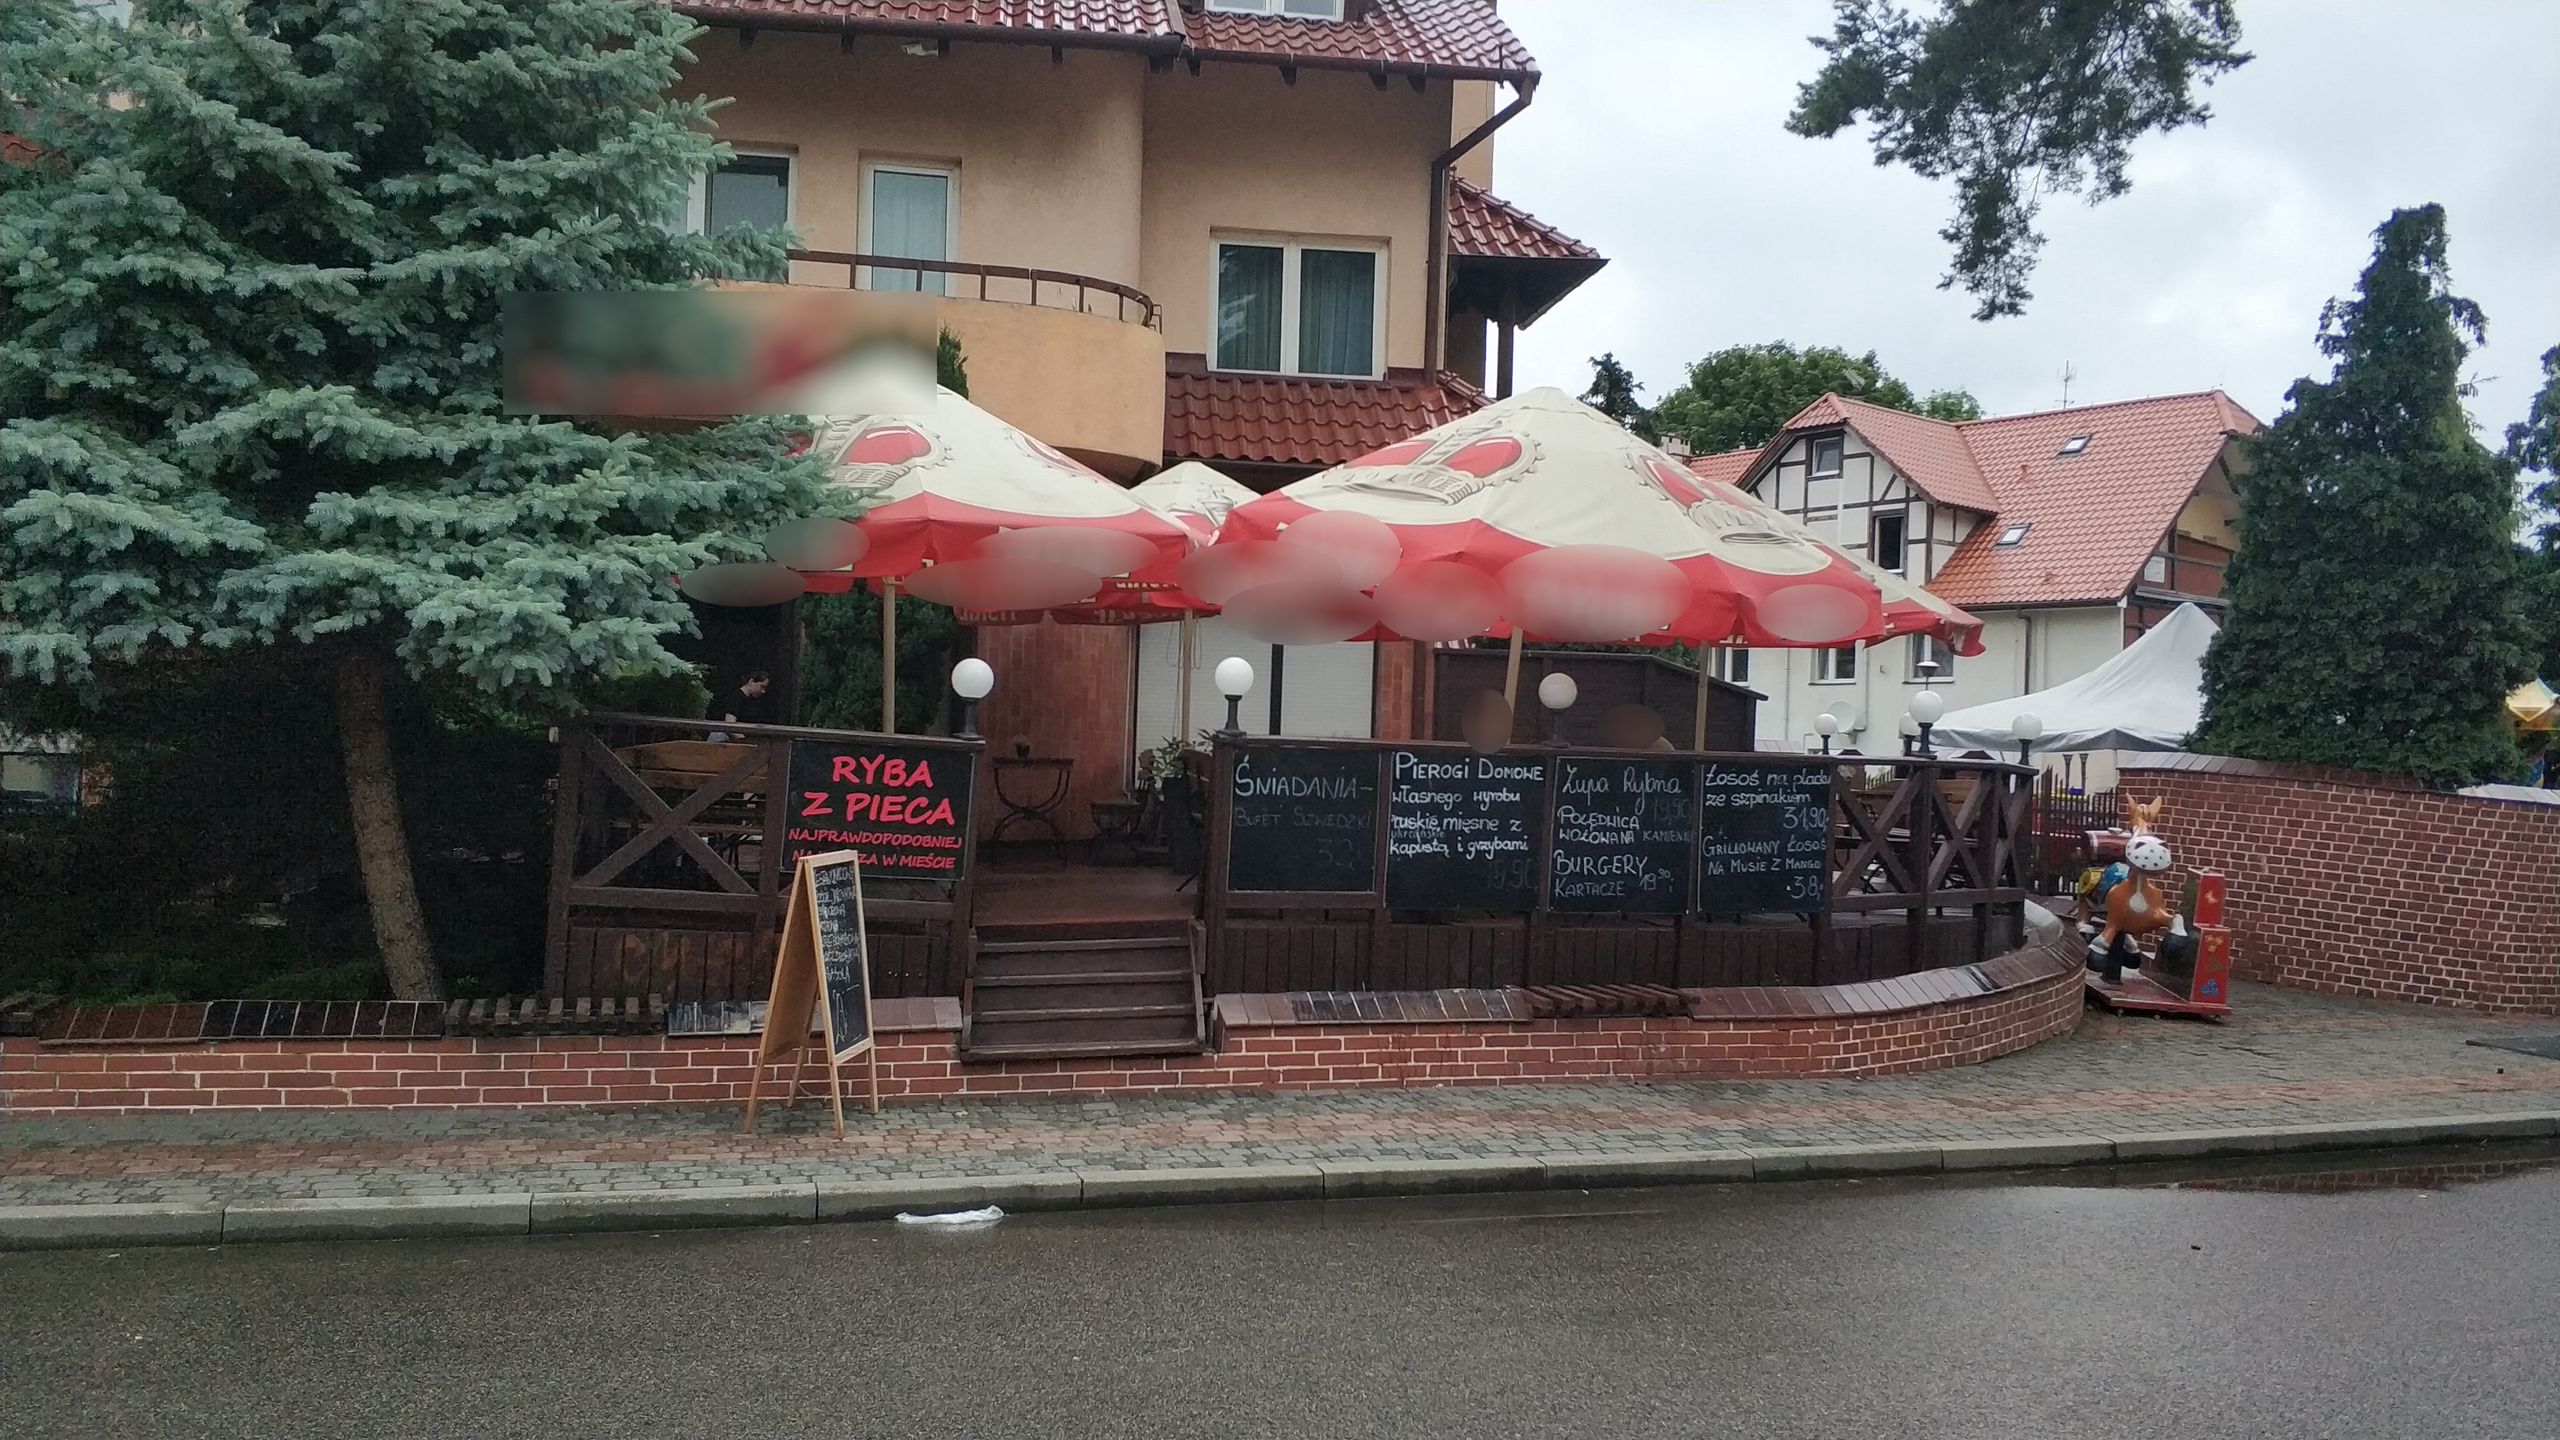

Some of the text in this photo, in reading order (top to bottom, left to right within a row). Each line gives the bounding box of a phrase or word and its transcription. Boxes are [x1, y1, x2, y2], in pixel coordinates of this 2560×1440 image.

[832, 754, 934, 789] RYBA
[1395, 751, 1544, 782] PIEROGI DOMOWE
[1705, 763, 1760, 786] Łosoś
[1766, 773, 1788, 786] na
[1392, 785, 1521, 811] własnego wyrobu
[1623, 766, 1682, 816] Rybna
[1705, 788, 1812, 809] ze szpinakiem
[802, 791, 955, 826] Z PIECA
[1443, 811, 1499, 834] mięsne
[1509, 818, 1524, 832] z
[788, 828, 963, 849] NAJPRAWDOPODOBNIEJ
[1389, 835, 1529, 861] kapustą i grzybami
[1702, 835, 1780, 857] GRILLOWANY
[883, 853, 897, 866] W
[899, 853, 956, 870] MIEŚCIE
[1553, 849, 1648, 878] BURGERY
[1707, 860, 1725, 876] NA
[1730, 856, 1767, 873] MUSIE
[1554, 877, 1625, 898] KARTACZE
